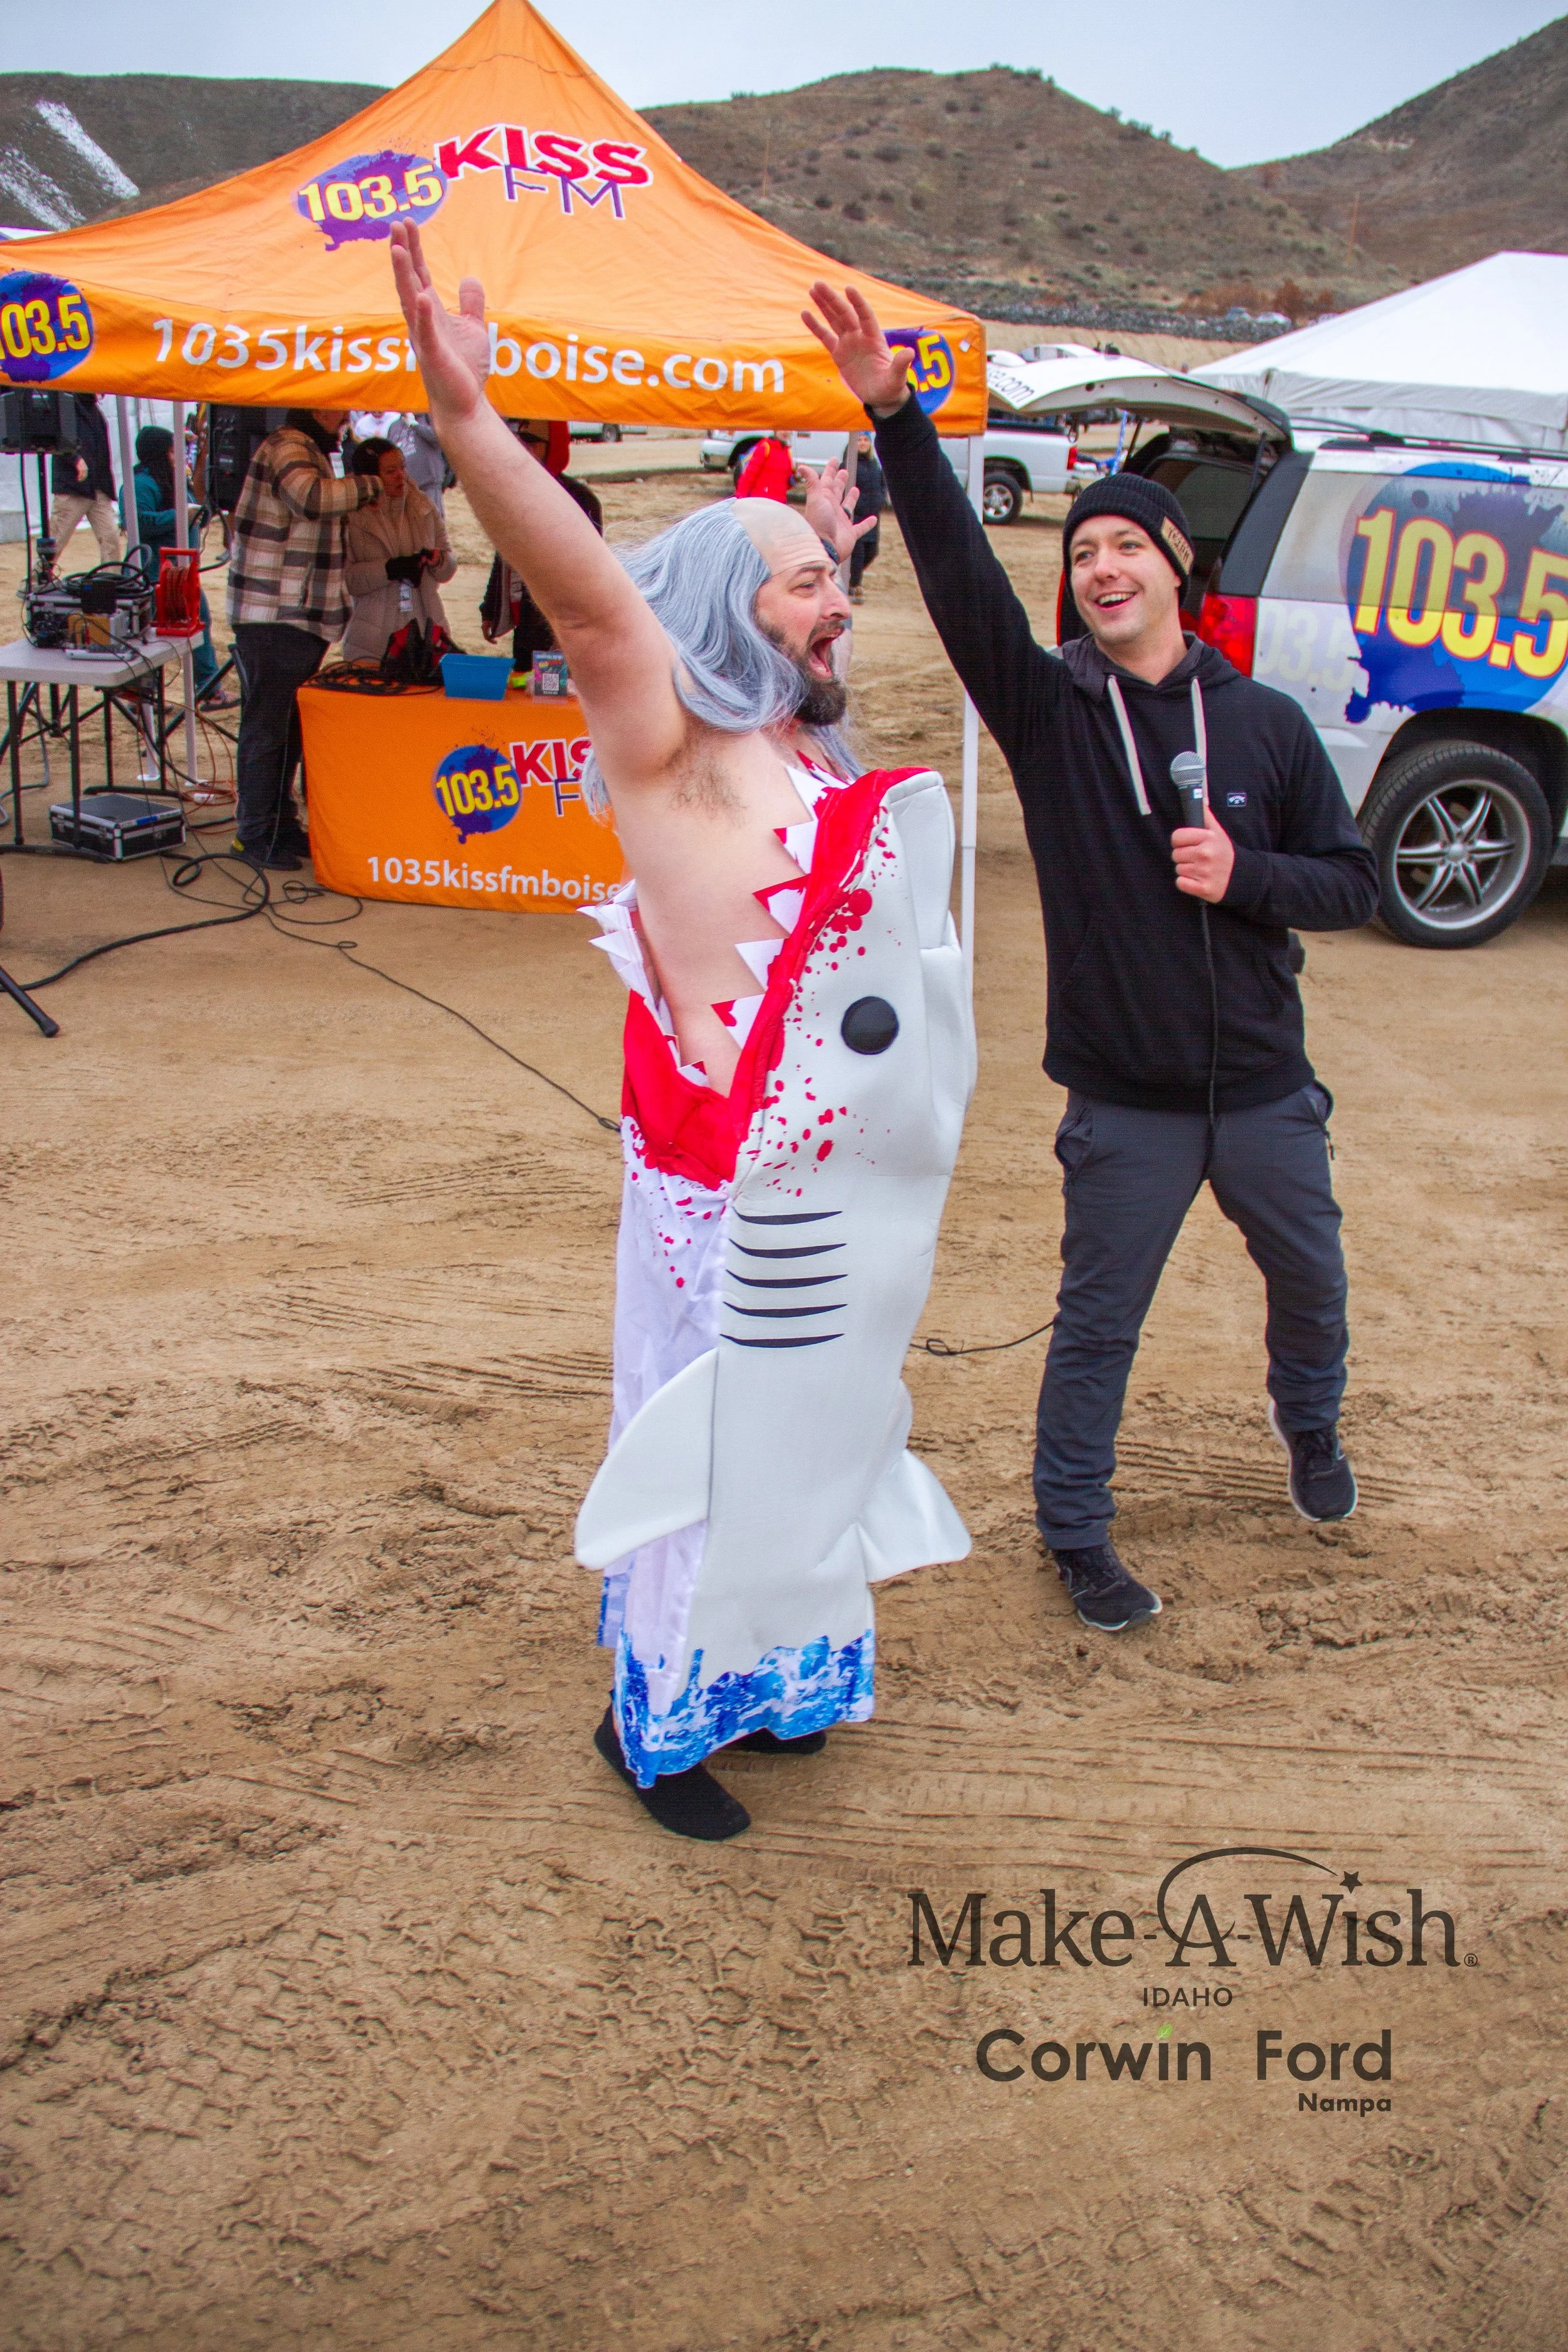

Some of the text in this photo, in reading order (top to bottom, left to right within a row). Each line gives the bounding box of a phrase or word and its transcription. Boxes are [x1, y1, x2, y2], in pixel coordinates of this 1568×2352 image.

[297, 124, 654, 222] 103.5 KISS
[502, 163, 627, 220] FM
[0, 292, 92, 361] 03.5
[1353, 505, 1568, 679] 103.5
[435, 764, 521, 817] 103.5
